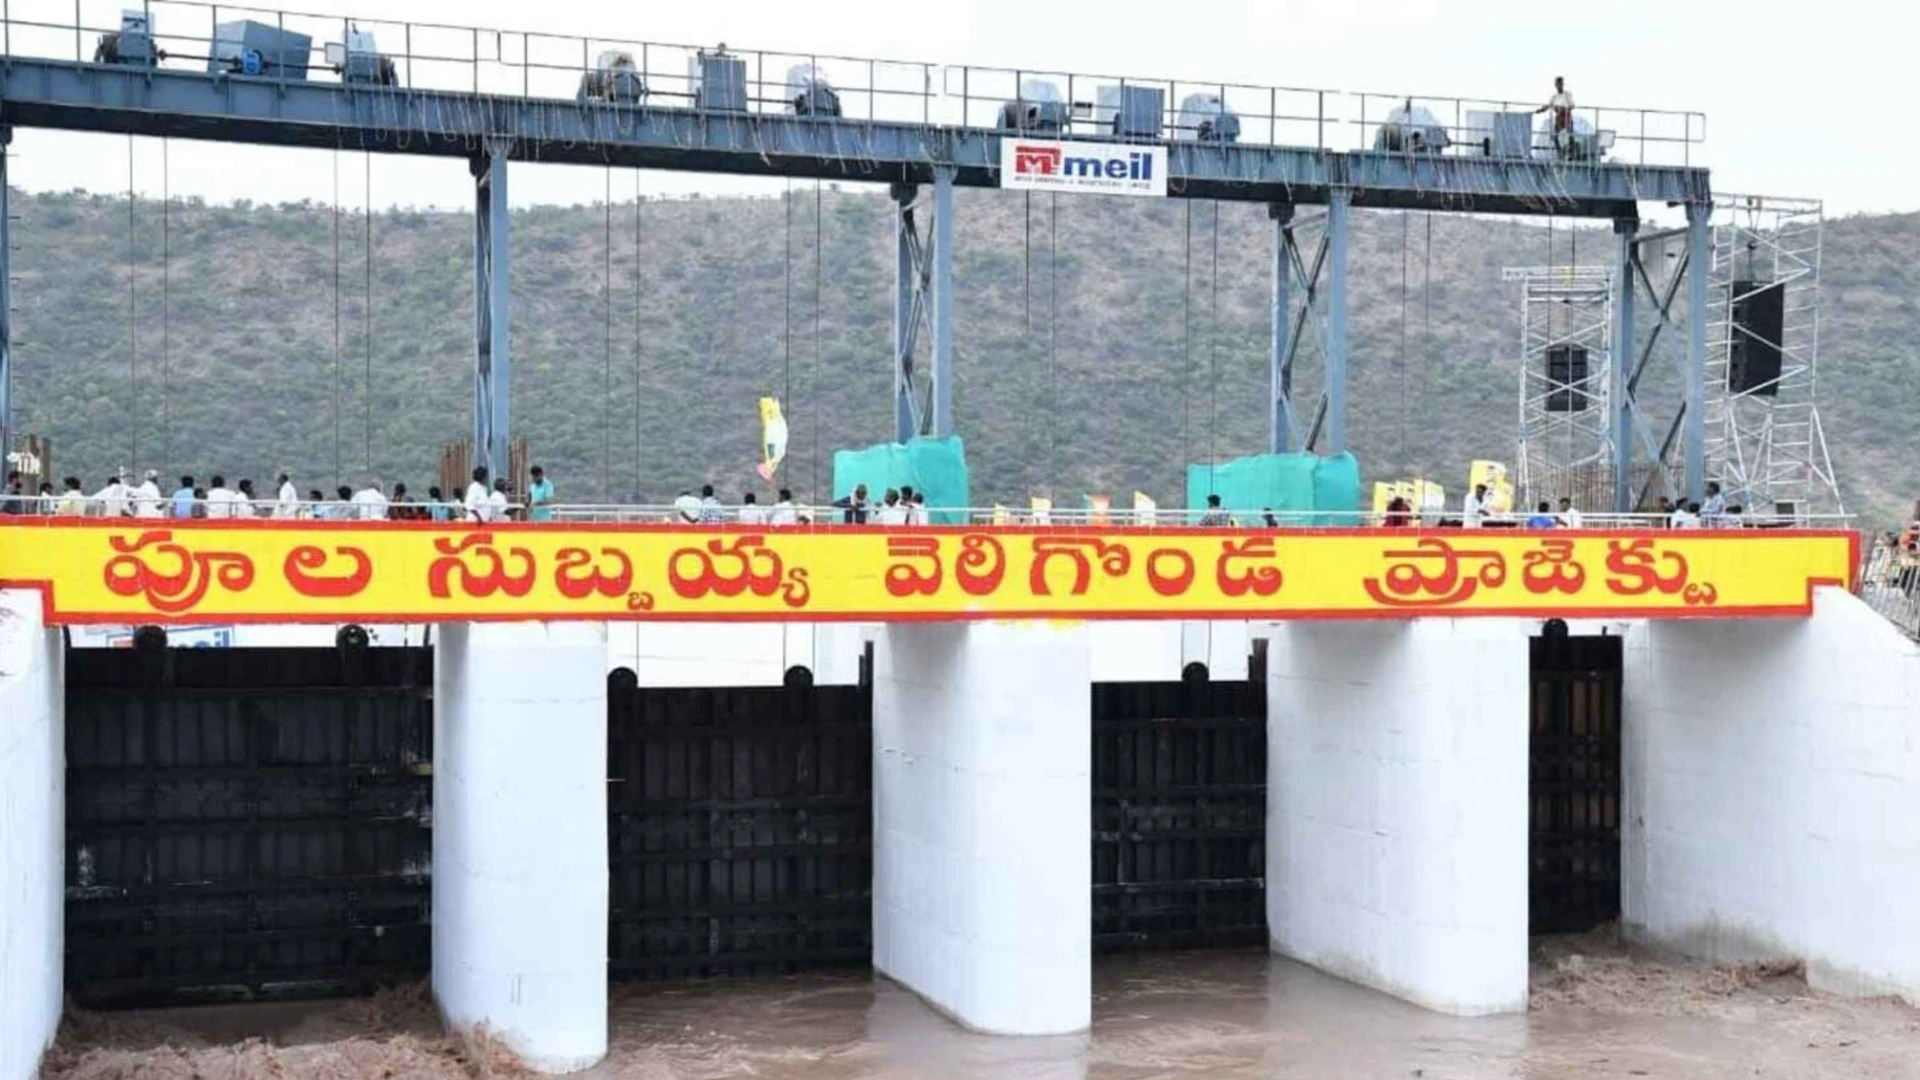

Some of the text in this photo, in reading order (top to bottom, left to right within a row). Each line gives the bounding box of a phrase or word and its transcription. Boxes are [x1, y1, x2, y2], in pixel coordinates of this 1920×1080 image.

[1064, 152, 1153, 180] meil
[103, 530, 1718, 613] పూల సుబ్బయ్య వెలిగొండ ప్రాజెక్టు
